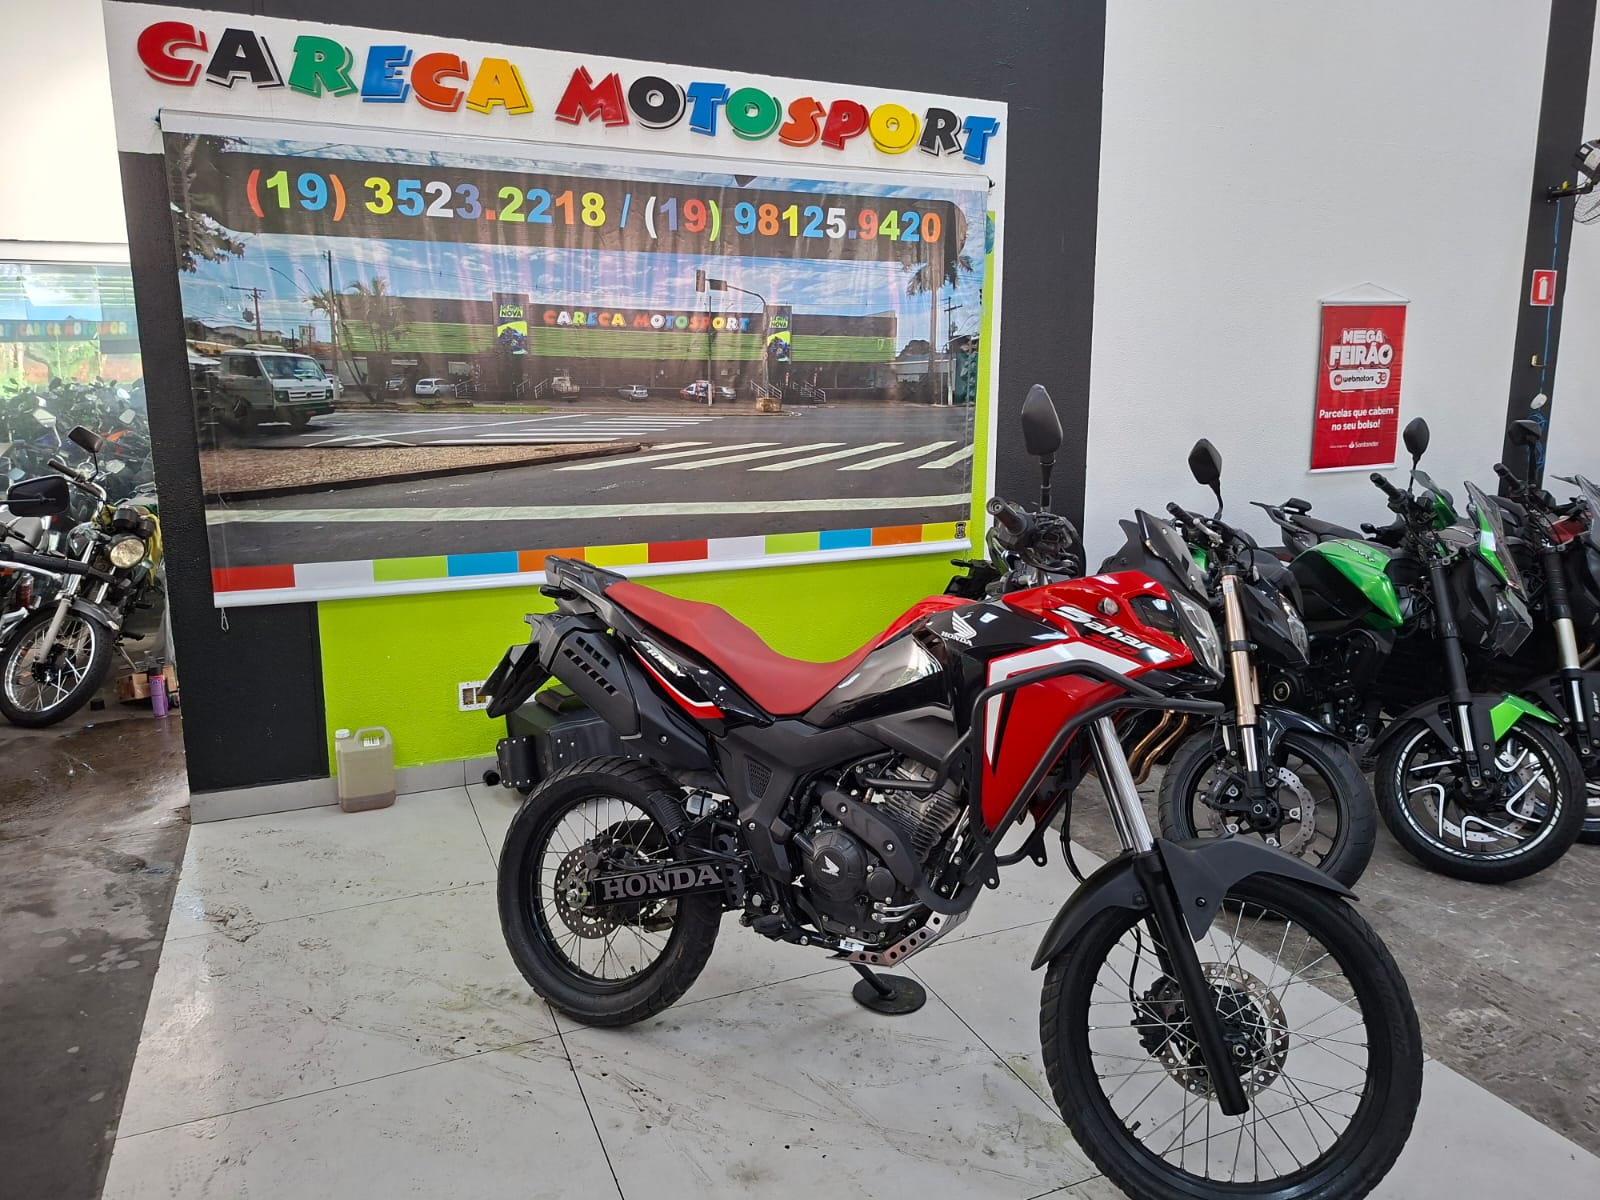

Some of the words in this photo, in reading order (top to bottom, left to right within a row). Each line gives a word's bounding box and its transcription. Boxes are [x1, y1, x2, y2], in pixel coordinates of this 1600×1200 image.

[137, 21, 534, 116] CARECA
[554, 65, 999, 165] MOTOSPORT
[246, 169, 346, 222] (19)
[364, 176, 606, 228] 3523.2218
[645, 195, 721, 242] (19)
[734, 201, 941, 242] 98125.9420
[543, 310, 626, 327] CARECA
[633, 313, 749, 331] MOTOSPORT
[1342, 329, 1383, 344] MEGA
[1329, 341, 1393, 365] FEIRÃO
[1343, 374, 1374, 382] webmotors
[1319, 408, 1352, 419] Parcelas
[1353, 409, 1367, 419] que
[1368, 405, 1394, 416] cabem
[1331, 423, 1342, 431] no
[1343, 421, 1356, 430] seu
[1357, 419, 1381, 430] bolso!
[941, 631, 973, 646] HONDA
[602, 864, 723, 900] HONDA
